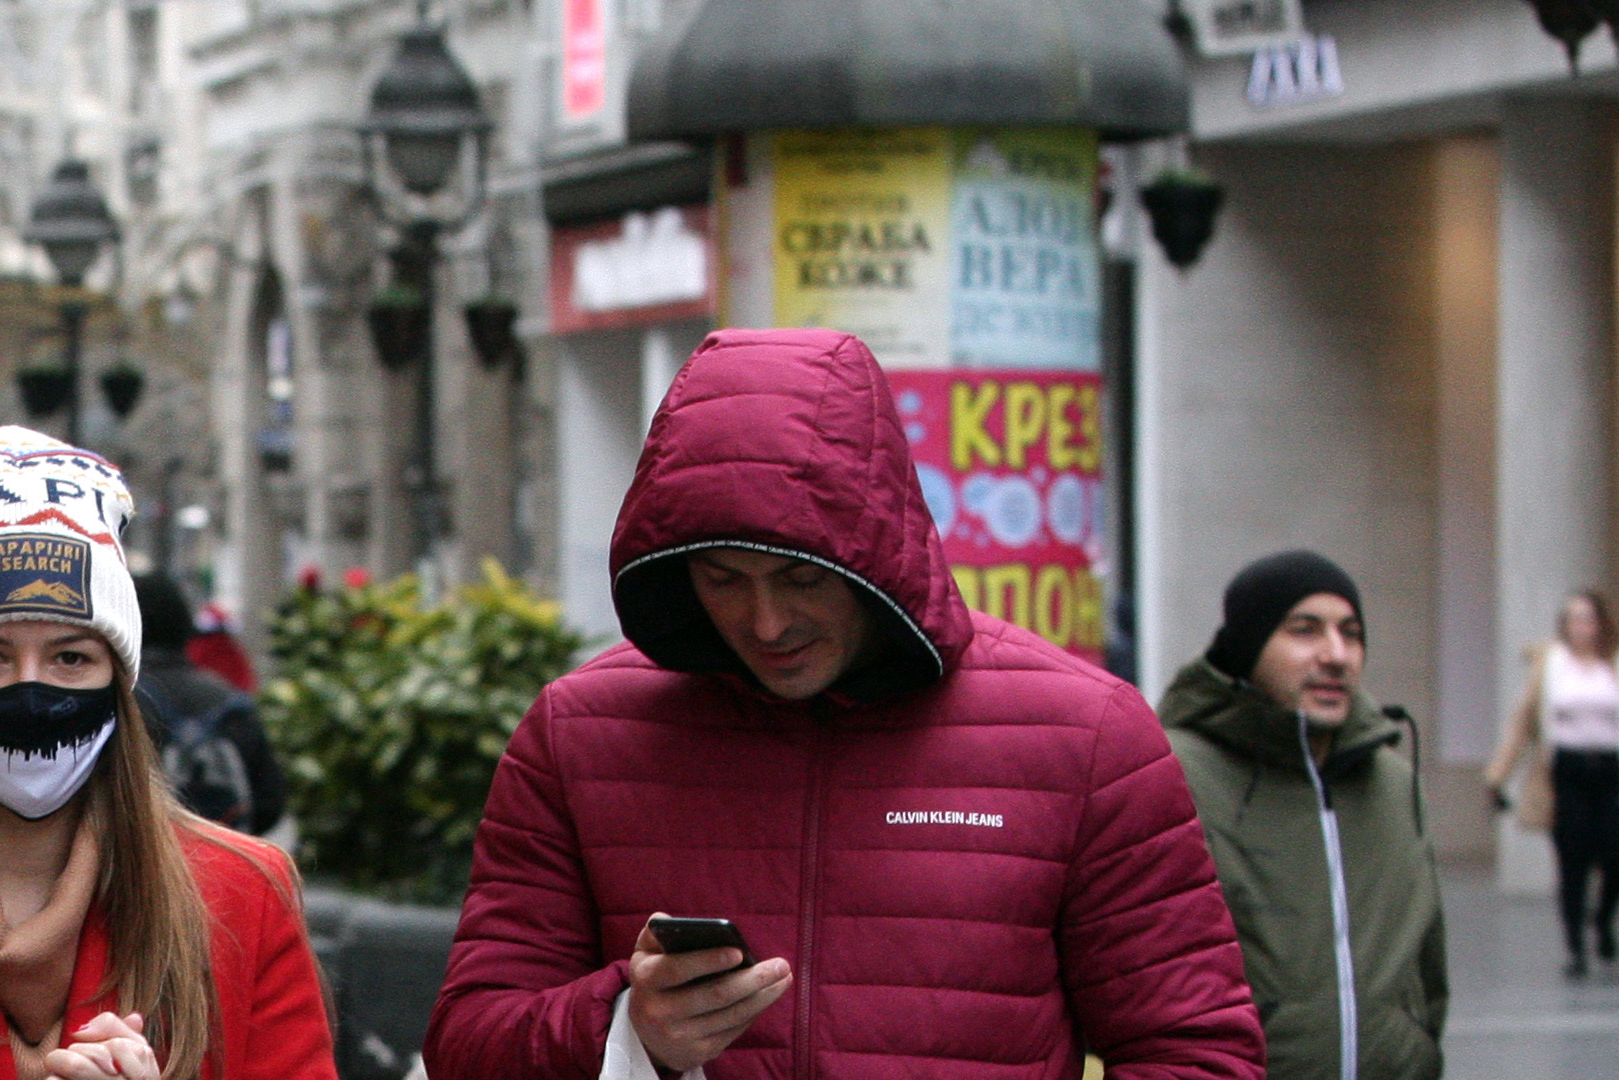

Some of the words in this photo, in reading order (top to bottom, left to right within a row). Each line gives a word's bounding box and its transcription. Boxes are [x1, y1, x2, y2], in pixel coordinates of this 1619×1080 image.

[886, 811, 928, 824] CALVIN
[930, 811, 964, 824] KLEIN
[965, 813, 1003, 828] JEANS
